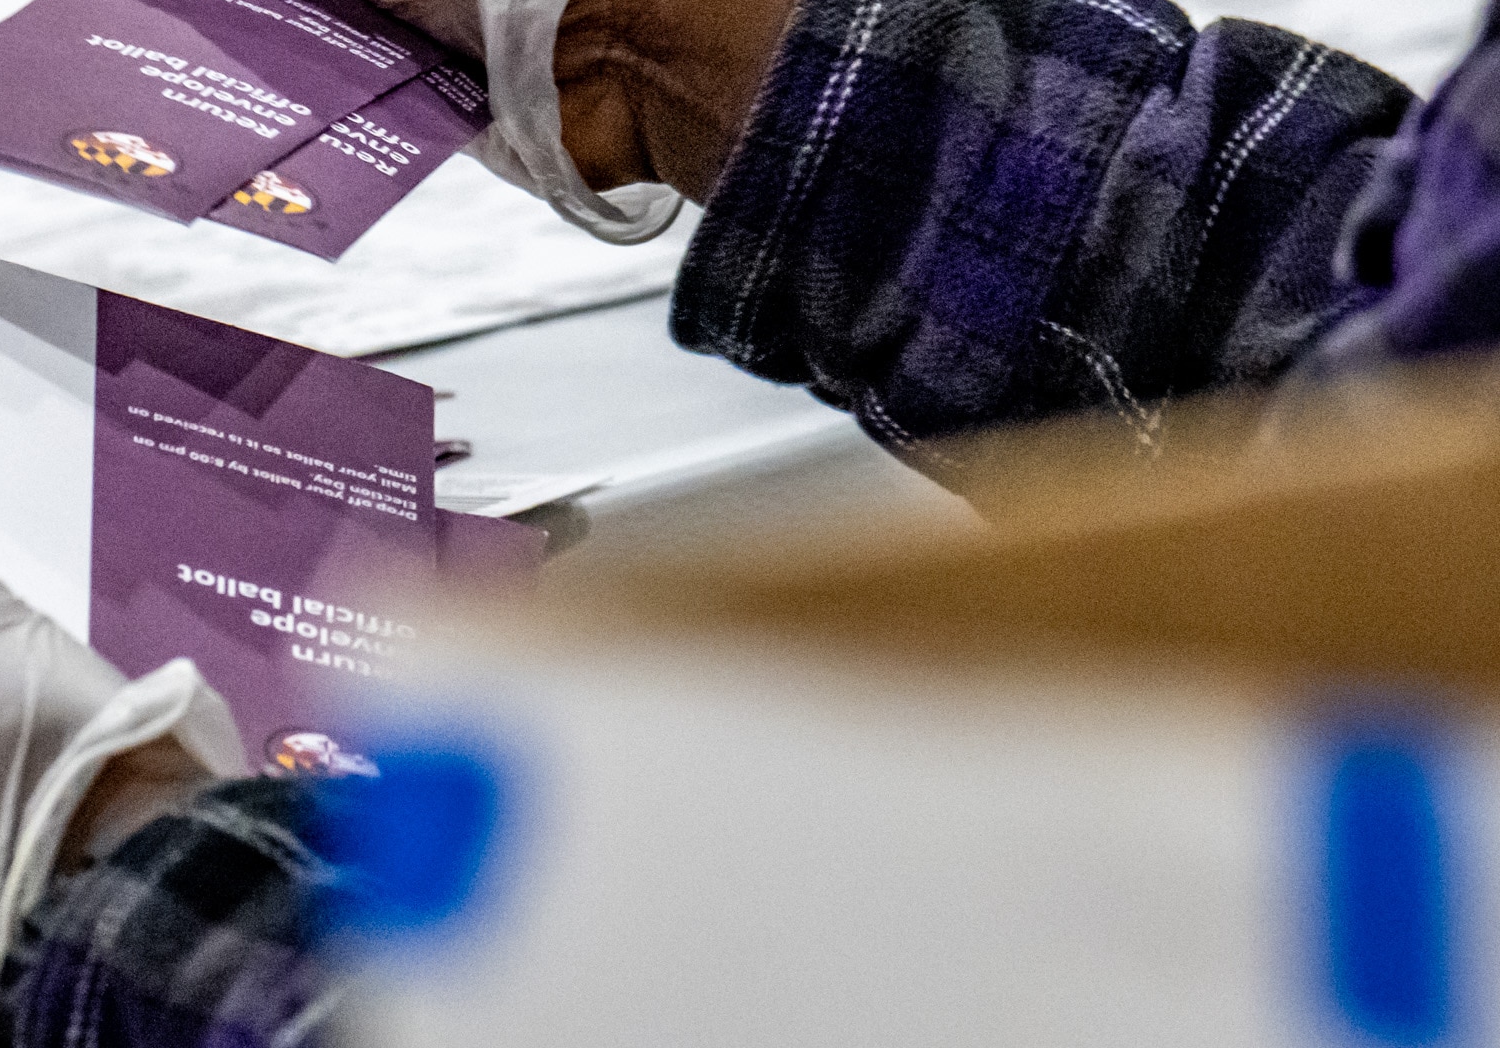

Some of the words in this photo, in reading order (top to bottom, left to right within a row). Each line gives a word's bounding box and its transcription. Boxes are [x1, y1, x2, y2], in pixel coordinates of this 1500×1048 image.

[236, 0, 284, 20] ballot
[285, 19, 326, 37] your
[332, 21, 370, 41] your
[85, 34, 189, 71] ballot
[322, 35, 348, 50] off
[333, 32, 395, 66] Election
[370, 40, 405, 60] Mail
[349, 48, 389, 69] Drop
[140, 65, 297, 127] envelope
[191, 66, 313, 116] official
[161, 88, 280, 139] Return
[330, 122, 411, 165] enve
[346, 112, 422, 155] offic
[319, 133, 399, 177] Retu
[128, 405, 150, 418] on
[153, 412, 225, 439] received
[133, 435, 155, 447] on
[159, 442, 187, 455] pm
[228, 433, 243, 445] is
[246, 438, 259, 450] it
[262, 443, 282, 455] so
[189, 451, 225, 468] 8:00
[228, 460, 249, 475] by
[286, 451, 335, 472] ballot
[252, 467, 302, 490] ballot
[309, 472, 346, 491] Day.
[338, 466, 378, 483] your
[374, 463, 417, 483] time.
[305, 483, 345, 500] your
[381, 477, 417, 495] Mail
[347, 495, 373, 508] off
[349, 484, 417, 511] Election
[376, 501, 418, 521] Drop
[177, 563, 281, 610] ballot
[293, 595, 416, 640] official
[250, 609, 390, 657] nvelope
[291, 643, 373, 677] turn
